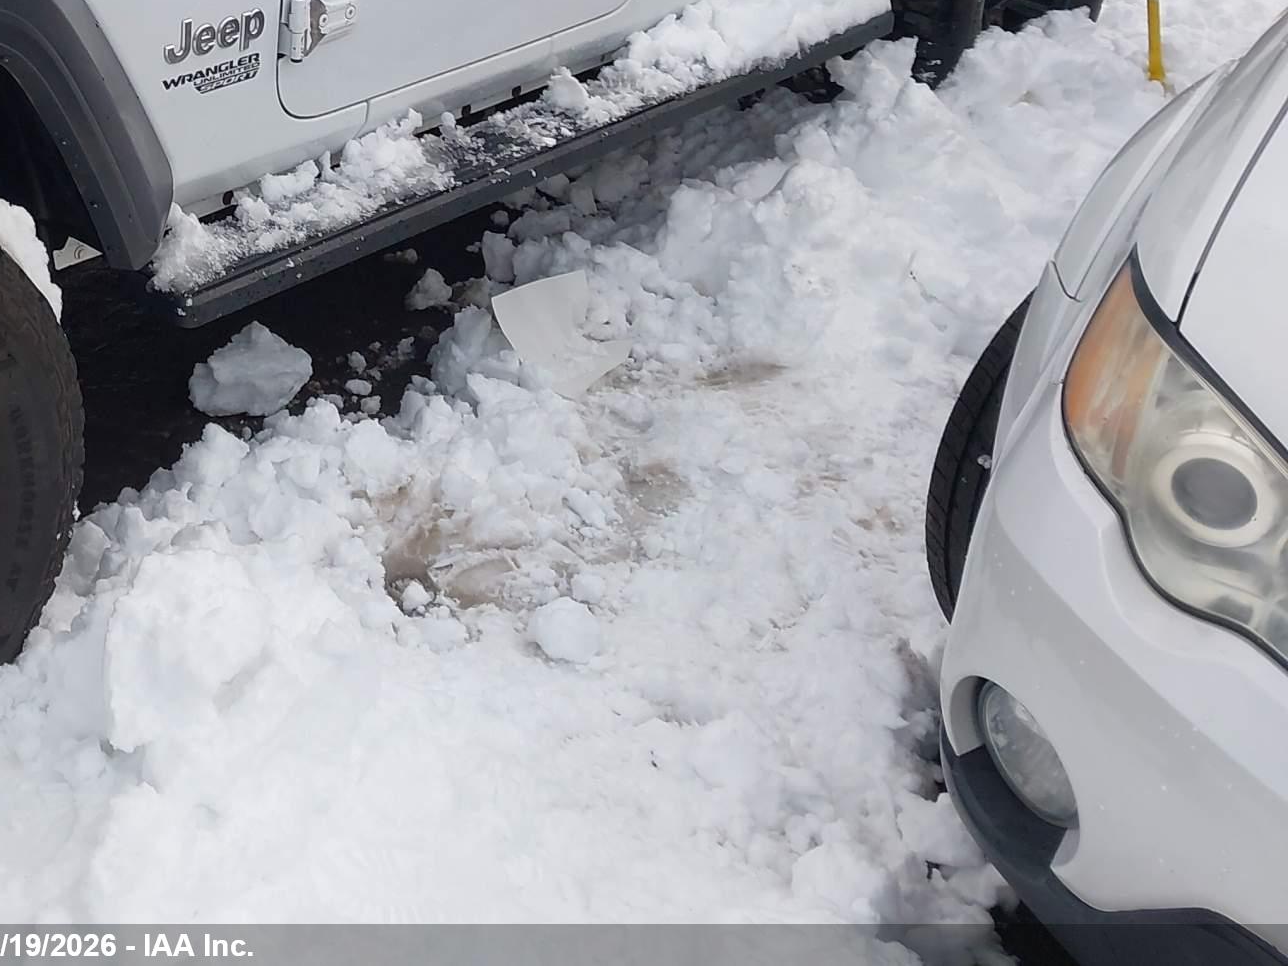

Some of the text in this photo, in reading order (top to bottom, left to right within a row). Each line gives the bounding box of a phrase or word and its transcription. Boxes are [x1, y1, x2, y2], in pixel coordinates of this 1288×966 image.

[164, 9, 265, 64] Jeep
[162, 53, 260, 90] WRANGLER
[193, 62, 260, 86] UNLIMITED
